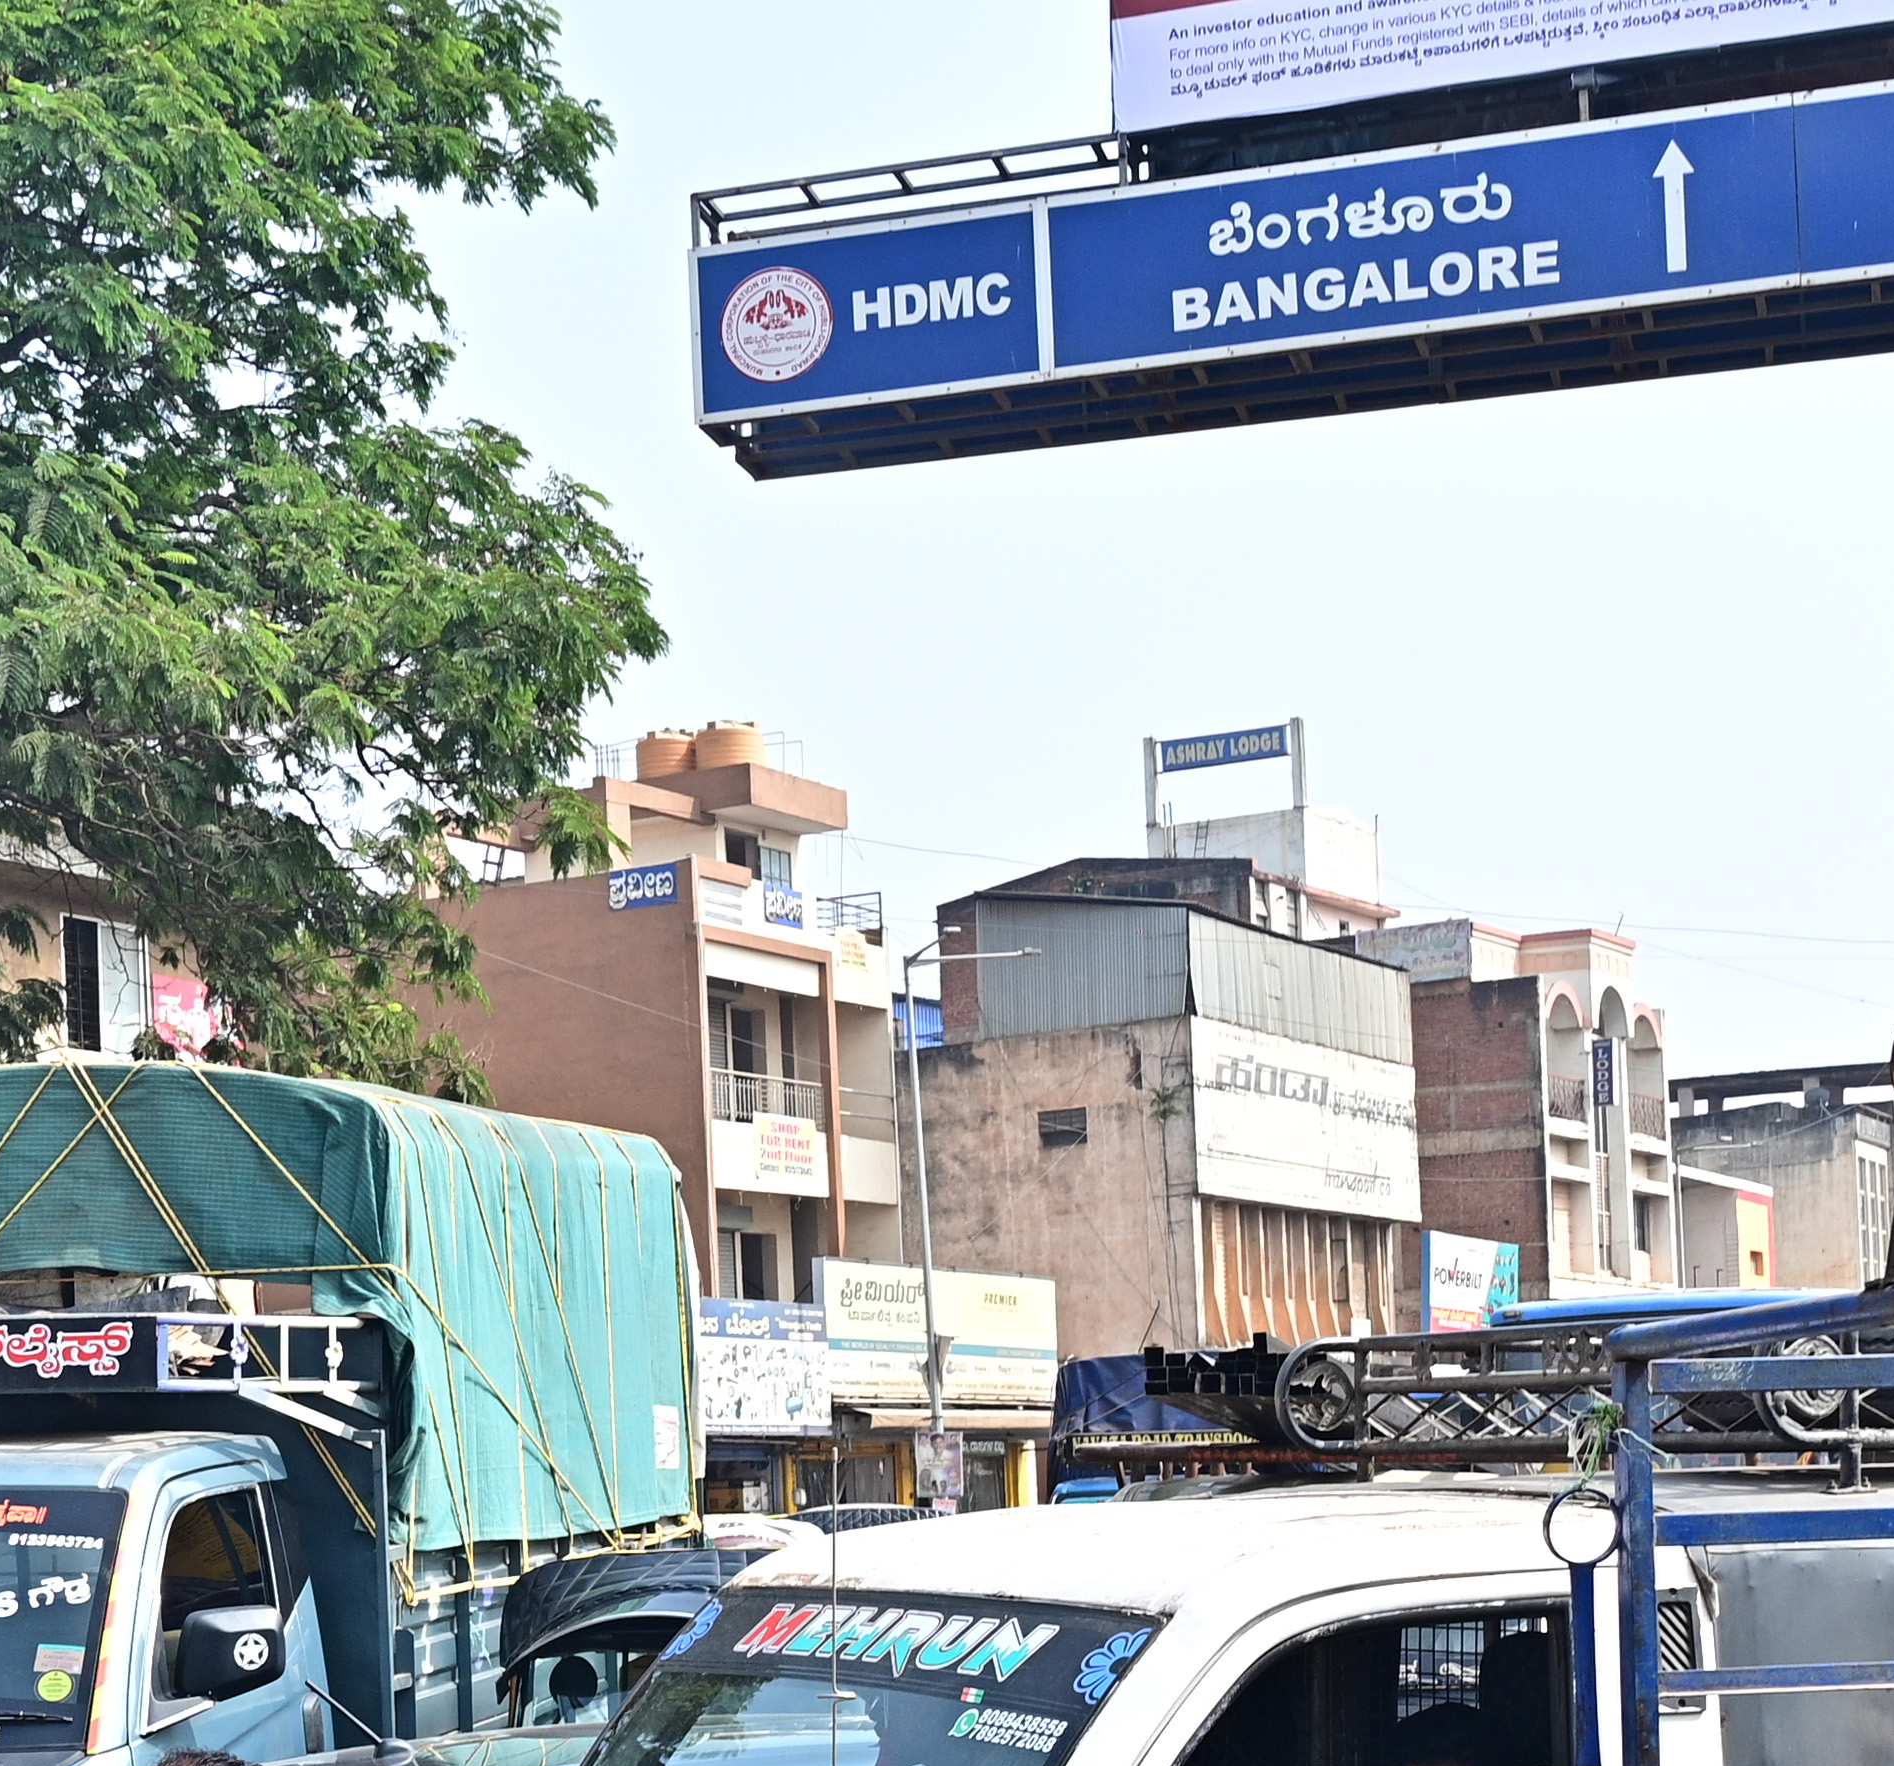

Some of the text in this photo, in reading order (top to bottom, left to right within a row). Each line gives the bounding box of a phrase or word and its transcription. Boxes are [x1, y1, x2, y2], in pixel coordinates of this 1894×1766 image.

[1168, 27, 1188, 41] An
[1193, 18, 1253, 37] investor
[1256, 7, 1330, 28] education
[1336, 1, 1363, 14] and
[1169, 46, 1191, 61] For
[1195, 43, 1228, 59] more
[1232, 37, 1256, 54] info
[1260, 37, 1277, 50] on
[1280, 28, 1315, 45] KYC,
[1319, 21, 1368, 42] change
[1372, 17, 1385, 31] in
[1388, 11, 1436, 29] various
[1440, 3, 1472, 20] KYC
[1476, 0, 1515, 16] details
[1170, 67, 1182, 79] to
[1186, 59, 1214, 77] deal
[1217, 54, 1245, 75] only
[1249, 50, 1275, 68] with
[1278, 47, 1300, 63] the
[1303, 40, 1349, 60] Mutual
[1352, 32, 1393, 52] Funds
[1397, 21, 1464, 46] registered
[1467, 19, 1495, 34] with
[1499, 11, 1538, 29] SEBI,
[1542, 5, 1586, 24] details
[1590, 1, 1603, 16] of
[1209, 172, 1512, 256] ಬೆಂಗಳೂರು
[761, 275, 773, 285] OF
[776, 274, 793, 282] THE
[795, 275, 814, 293] CITY
[851, 272, 1012, 331] HDMC
[1171, 240, 1561, 332] BANGALORE
[1166, 731, 1281, 766] ASHRAY LODGE
[609, 870, 674, 911] ಪ್ರವೀಣ
[1596, 1048, 1610, 1104] LODGE
[761, 1134, 811, 1150] FOR RENT
[771, 1122, 800, 1135] SHOP
[733, 1603, 1060, 1683] MEHRUN
[968, 1723, 1056, 1753] 7892572088
[978, 1708, 1068, 1738] 8088438558
